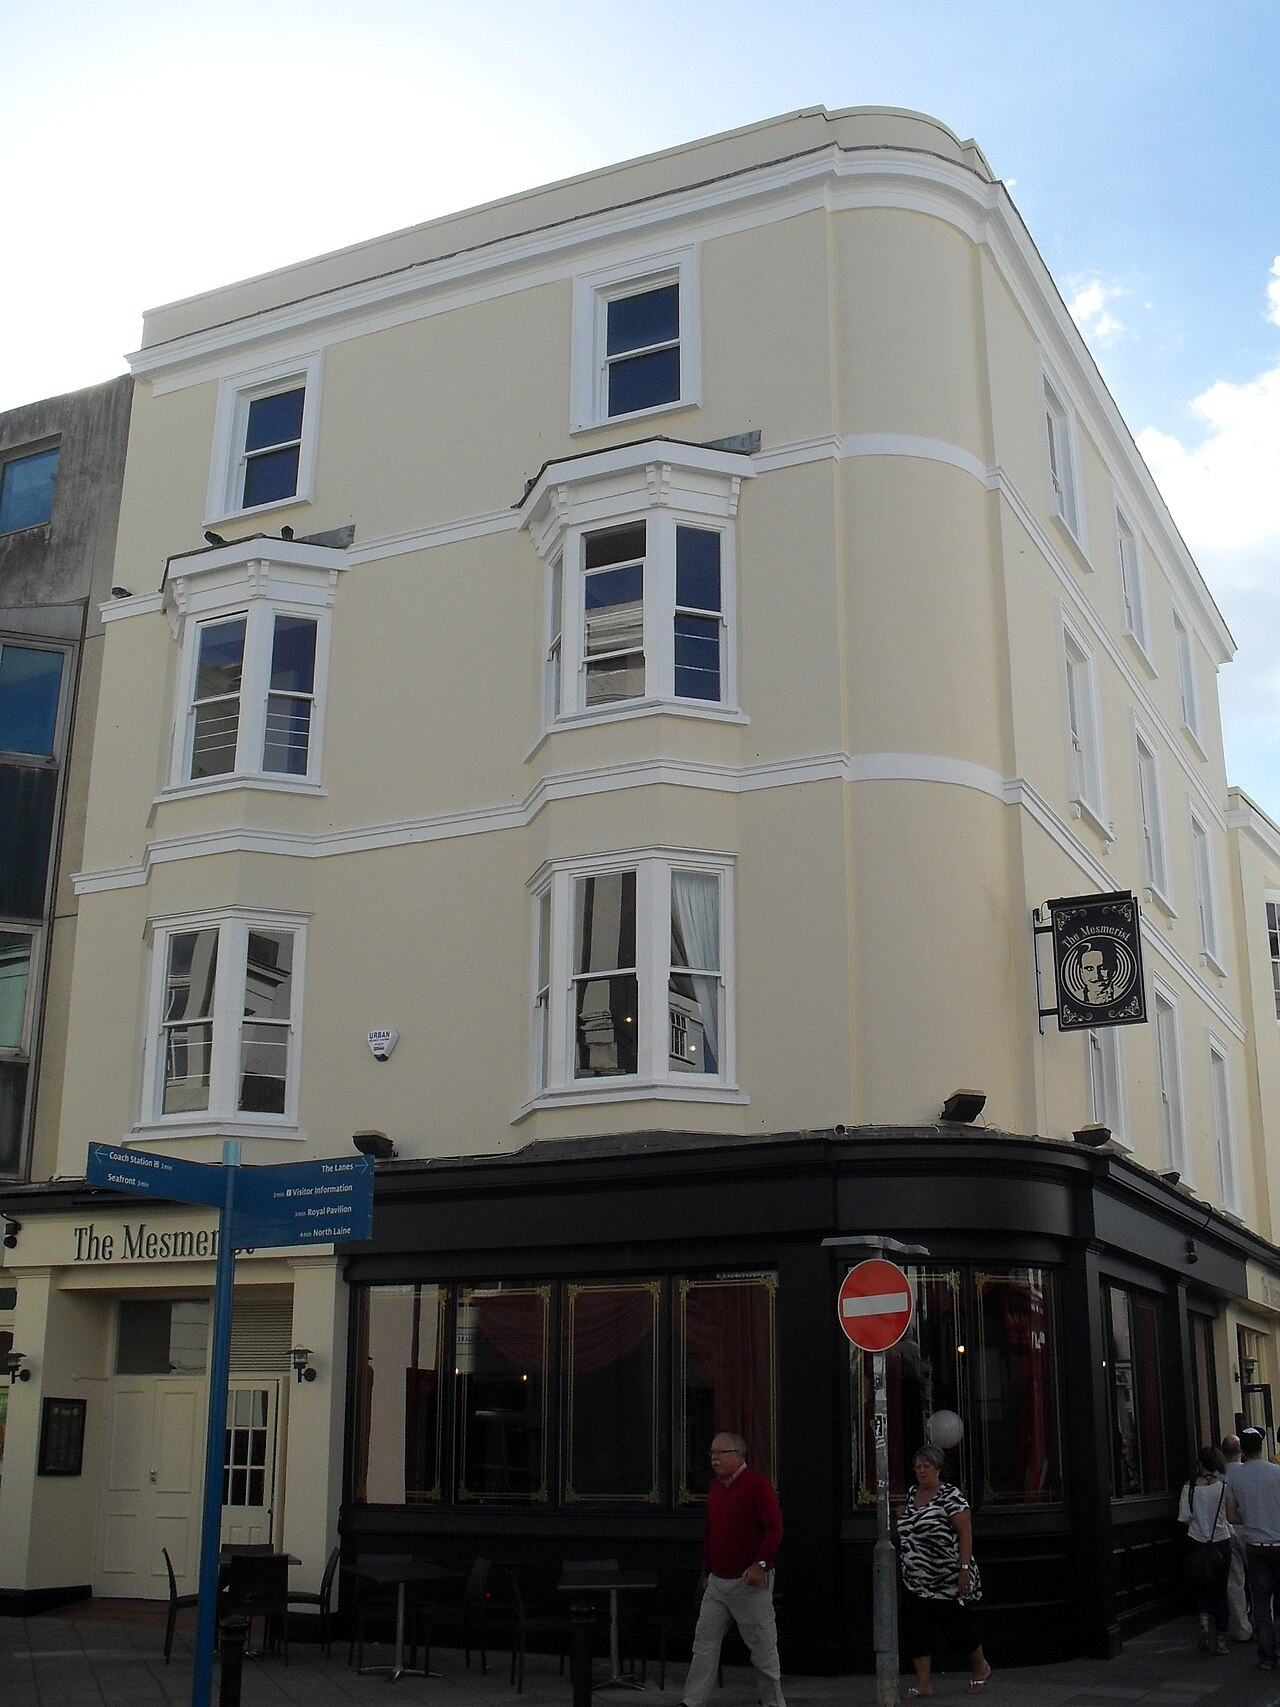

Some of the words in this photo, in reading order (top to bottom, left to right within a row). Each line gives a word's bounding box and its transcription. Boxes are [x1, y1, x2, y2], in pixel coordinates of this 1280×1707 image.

[1061, 933, 1080, 948] The
[1080, 925, 1131, 941] Mesmerist
[369, 1031, 390, 1039] URBAN
[109, 1151, 130, 1162] Coach
[130, 1155, 153, 1167] Station
[321, 1165, 334, 1173] The
[334, 1163, 354, 1172] Lanes
[107, 1173, 136, 1186] Seafront
[292, 1187, 314, 1196] Visitor
[314, 1183, 353, 1194] Information
[307, 1206, 326, 1218] Royal
[326, 1204, 352, 1215] Pavilion
[313, 1227, 333, 1237] North
[333, 1226, 351, 1236] Laine
[73, 1223, 114, 1262] The
[121, 1224, 255, 1260] Mesmer
